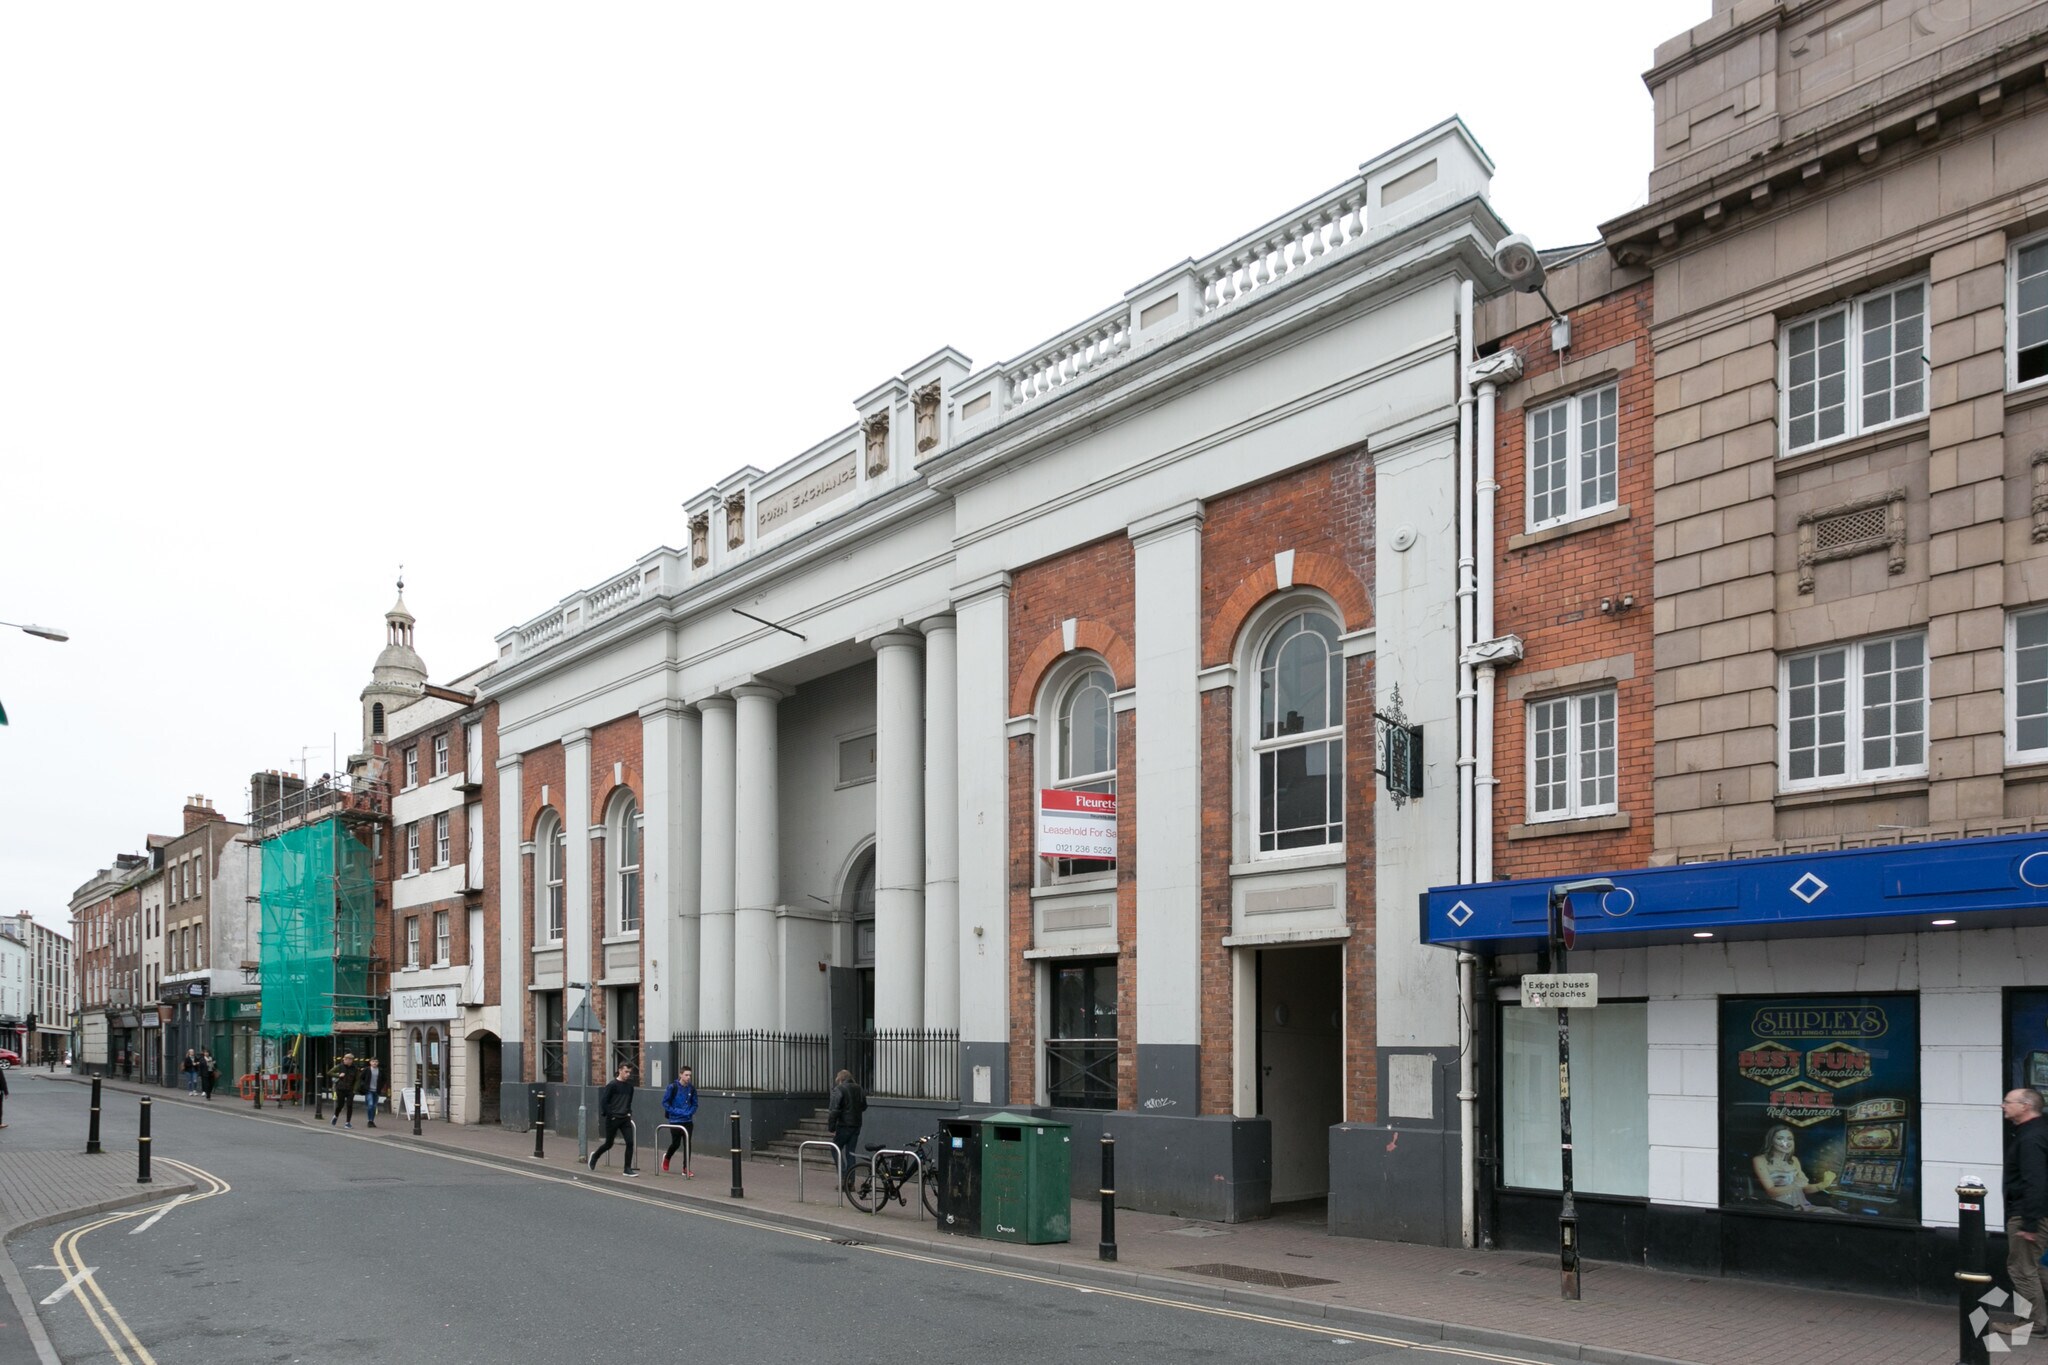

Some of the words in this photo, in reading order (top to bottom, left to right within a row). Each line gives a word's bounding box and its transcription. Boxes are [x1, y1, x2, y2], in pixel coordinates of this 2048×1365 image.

[760, 501, 788, 525] CORN
[793, 465, 856, 509] EXCHANGE
[1076, 795, 1116, 809] Fleurets
[1043, 825, 1087, 837] Leasehold
[1089, 827, 1103, 837] For
[1055, 843, 1073, 852] 0121
[1075, 844, 1091, 853] 236
[1093, 845, 1112, 854] 5252
[1528, 981, 1560, 990] Except
[1562, 981, 1590, 989] buses
[1549, 990, 1587, 998] coaches
[1758, 1011, 1881, 1033] SHIPLEYS
[1738, 1050, 1802, 1068] BEST
[1811, 1052, 1867, 1070] FUN
[1747, 1066, 1796, 1078] Jackpots
[1807, 1068, 1874, 1078] Promotions
[1769, 1090, 1835, 1108] FREE
[1766, 1106, 1841, 1118] Refreshments
